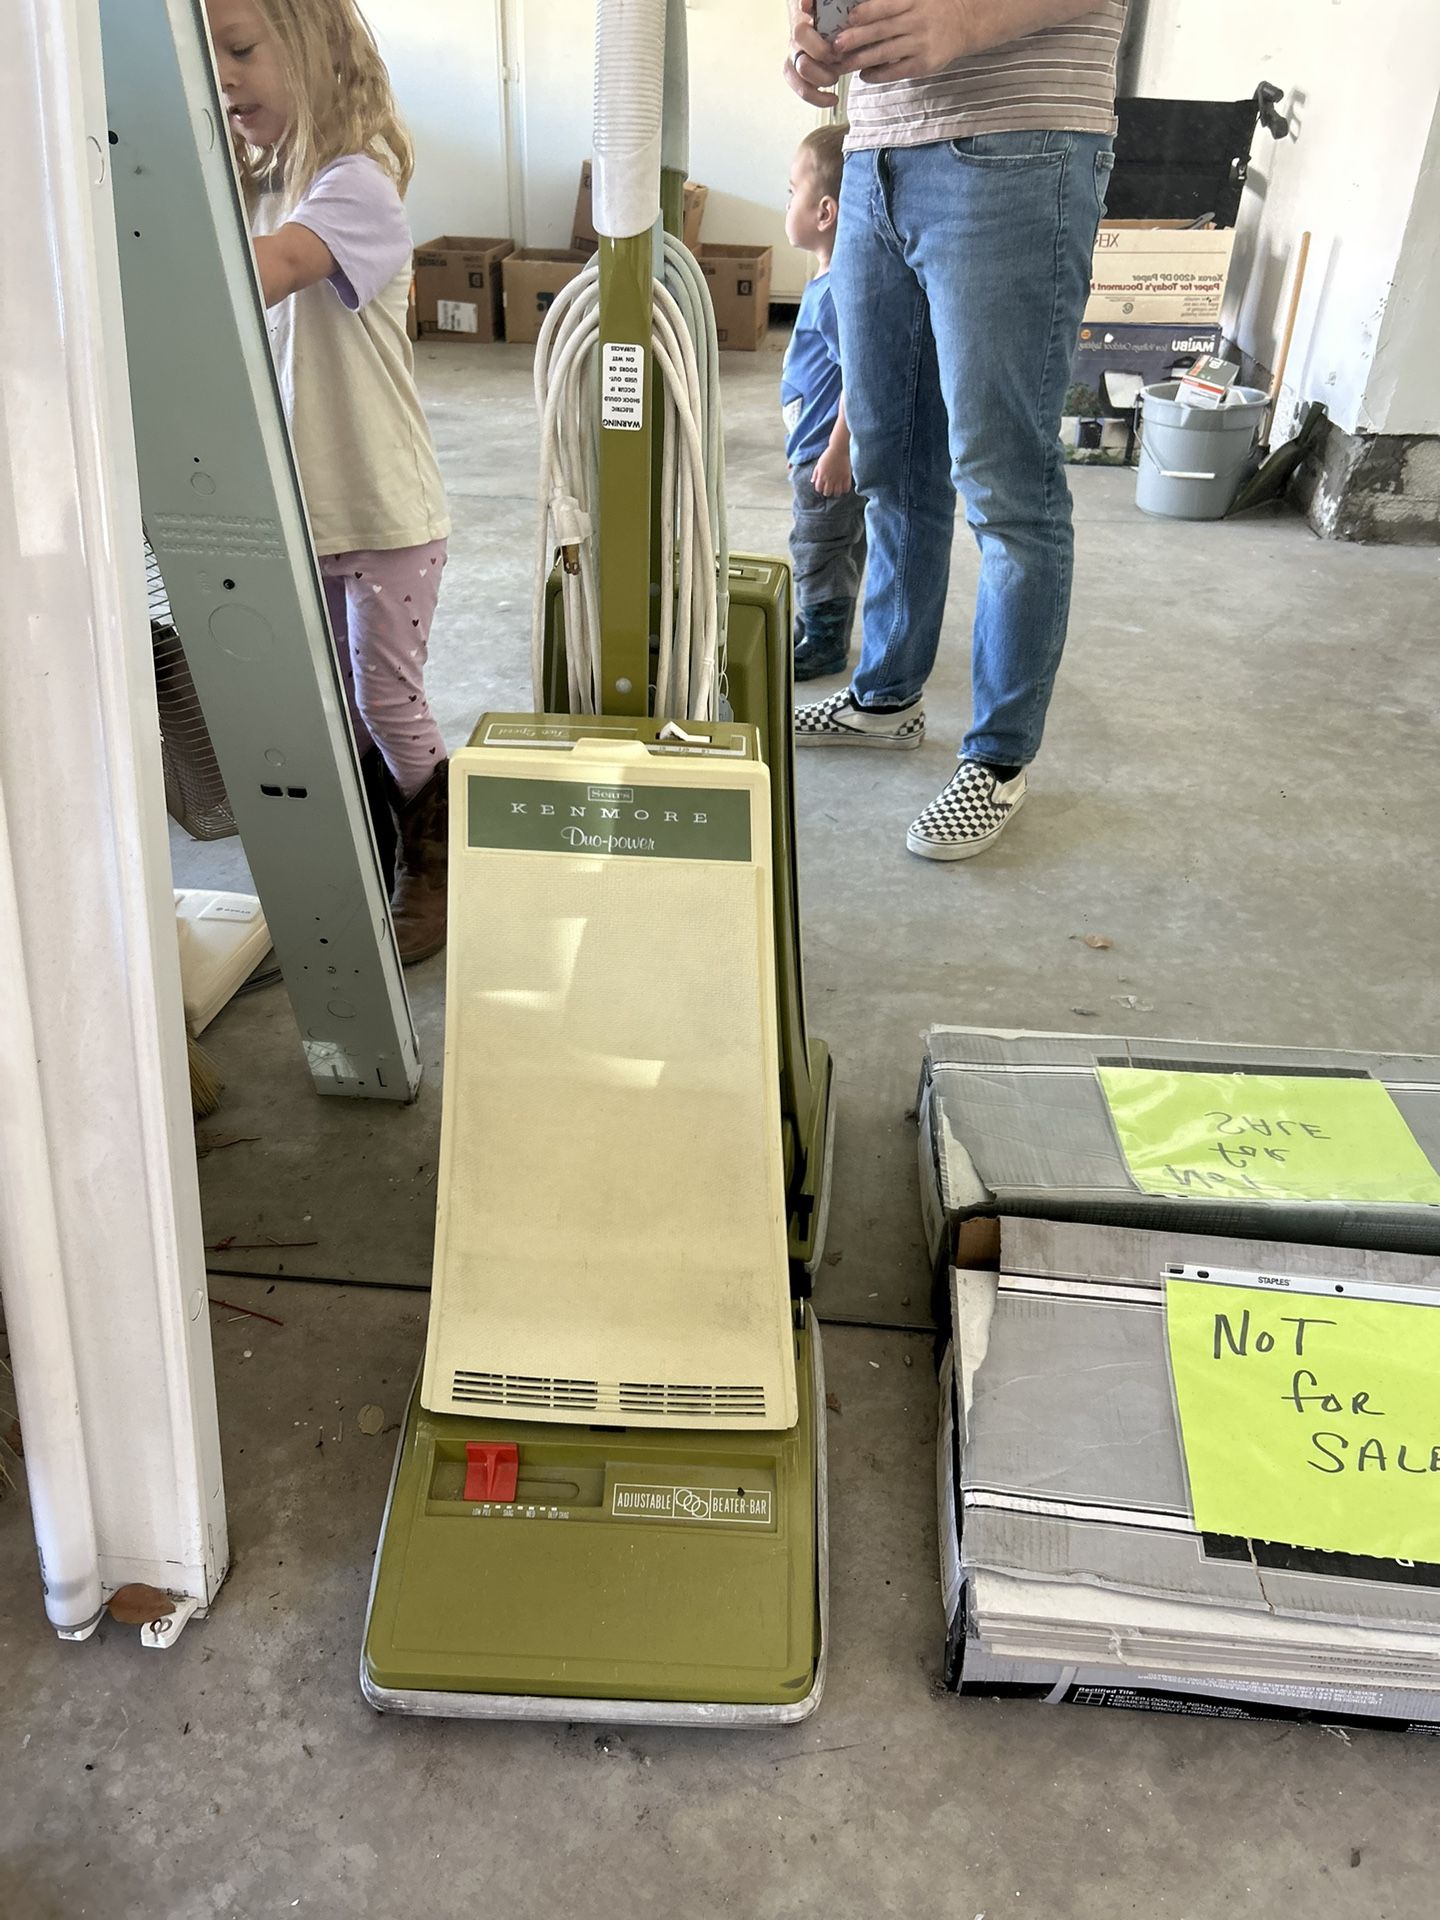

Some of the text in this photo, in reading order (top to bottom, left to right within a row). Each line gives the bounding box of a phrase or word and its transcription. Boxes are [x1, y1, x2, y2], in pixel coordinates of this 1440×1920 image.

[602, 418, 641, 429] WARNING
[590, 789, 631, 800] Sears
[511, 802, 708, 824] KENMORE
[560, 826, 656, 853] Duo-power
[616, 1491, 767, 1515] ADJUSTABLE BEATER-BAR
[1078, 1686, 1117, 1695] Rectified
[1186, 1701, 1243, 1712] INSTALLATION
